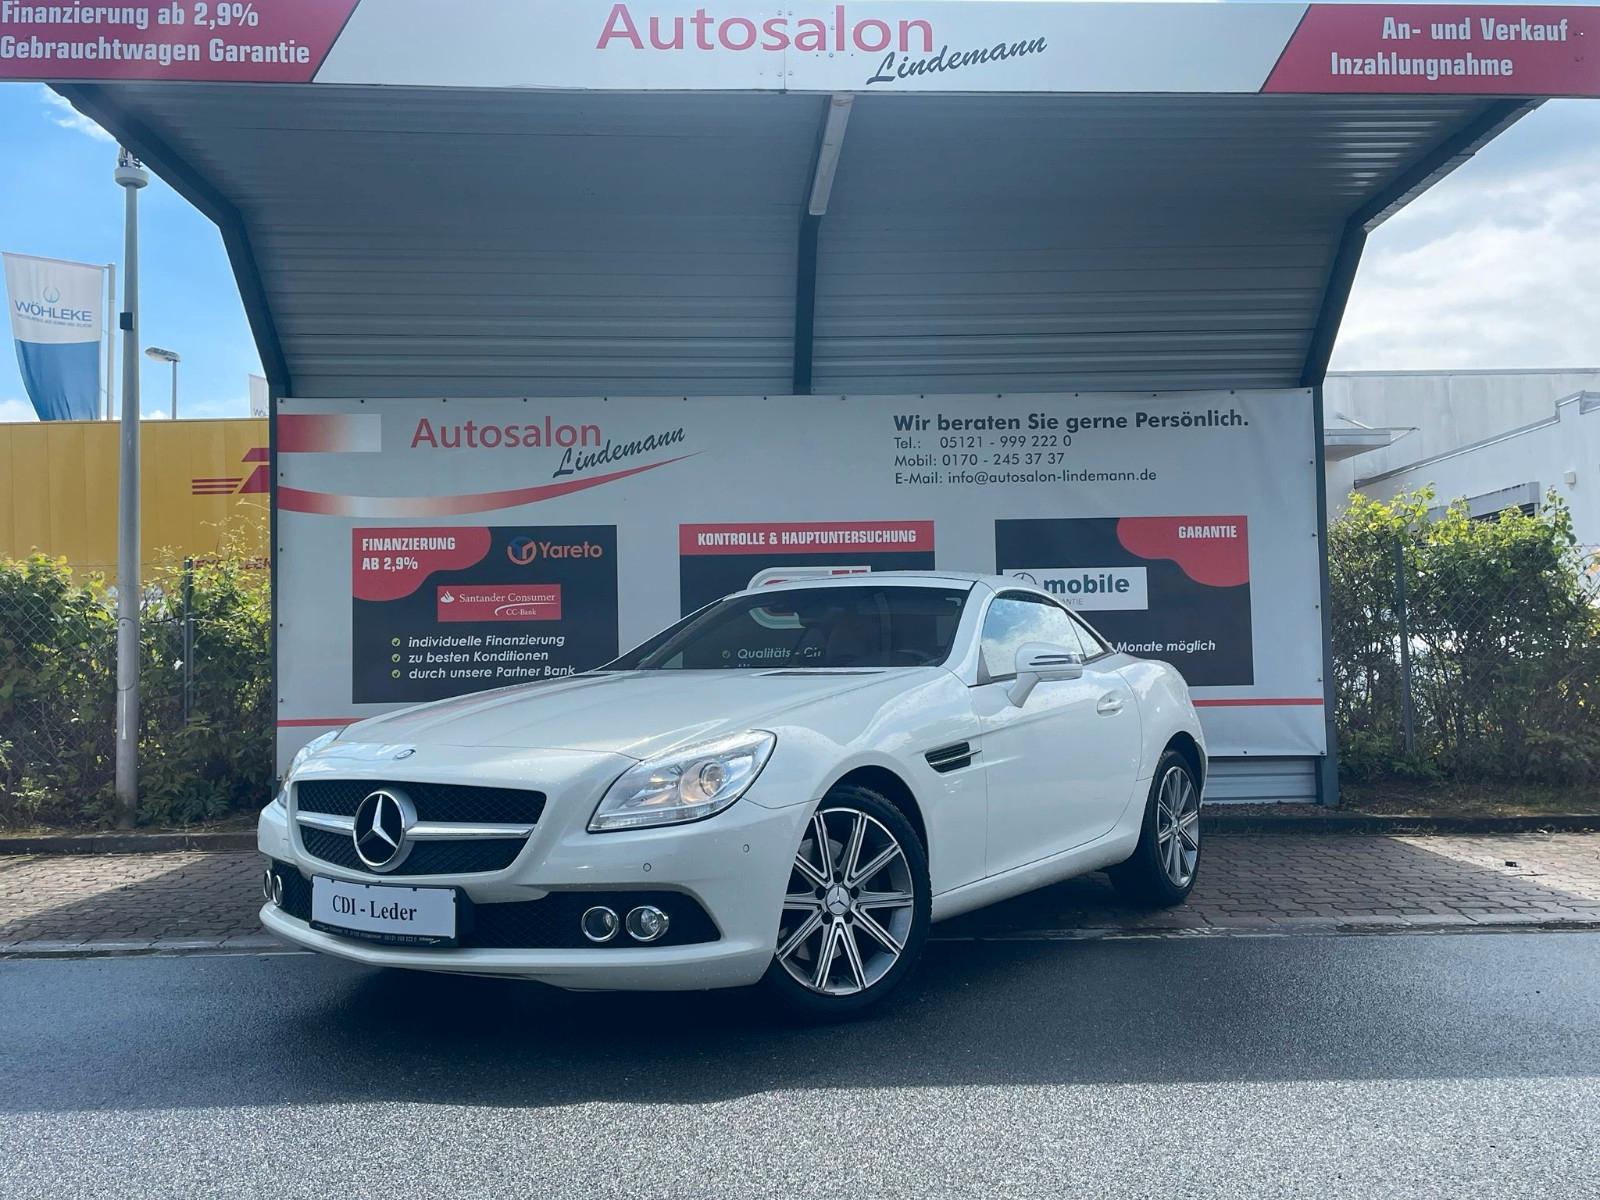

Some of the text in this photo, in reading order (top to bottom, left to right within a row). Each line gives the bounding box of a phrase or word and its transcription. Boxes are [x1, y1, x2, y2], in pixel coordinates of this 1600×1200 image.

[1, 0, 259, 30] Finanzierung ab 2,9%
[596, 4, 933, 52] Autosalon
[1382, 17, 1568, 41] An- und Verkauf
[0, 36, 310, 66] Gebrauchtwagen Garantie
[866, 36, 1047, 85] Lindemann
[1331, 52, 1513, 80] Inzahlungnahme
[15, 300, 92, 321] WÖHLEKE
[894, 409, 1249, 433] Wir beraten Sie gerne Persönlich.
[411, 416, 600, 448] Autosalon
[894, 437, 921, 449] Tel.:
[940, 436, 983, 448] 05121
[1000, 436, 1026, 448] 999
[1032, 435, 1058, 448] 222
[1063, 435, 1072, 447] 0
[553, 427, 685, 478] Lindemann
[894, 454, 937, 467] Mobil:
[942, 454, 978, 466] 0170
[994, 453, 1020, 466] 245
[1025, 453, 1041, 465] 37
[1047, 453, 1065, 465] 37
[895, 469, 1157, 486] E-Mail: info@autosalon-lindemann.de
[698, 530, 917, 546] KONTROLLE & HAUPTUNTERSUCHUNG
[1178, 526, 1237, 539] GARANTIE
[362, 537, 456, 551] FINANZIERUNG
[539, 541, 603, 559] Yareto
[362, 557, 418, 572] AB 2,9%
[1043, 574, 1130, 594] mobile
[459, 592, 556, 603] Santander Consumer
[506, 608, 537, 616] CC-Bank
[408, 635, 565, 647] individuelle Finanzierung
[1117, 641, 1163, 652] Monate
[1166, 640, 1216, 653] möglich
[408, 650, 549, 663] zu besten Konditionen
[737, 647, 791, 659] Qualitäts
[409, 665, 575, 679] durch unsere Partner Bank
[332, 894, 356, 915] CDI
[370, 901, 417, 921] Leder
